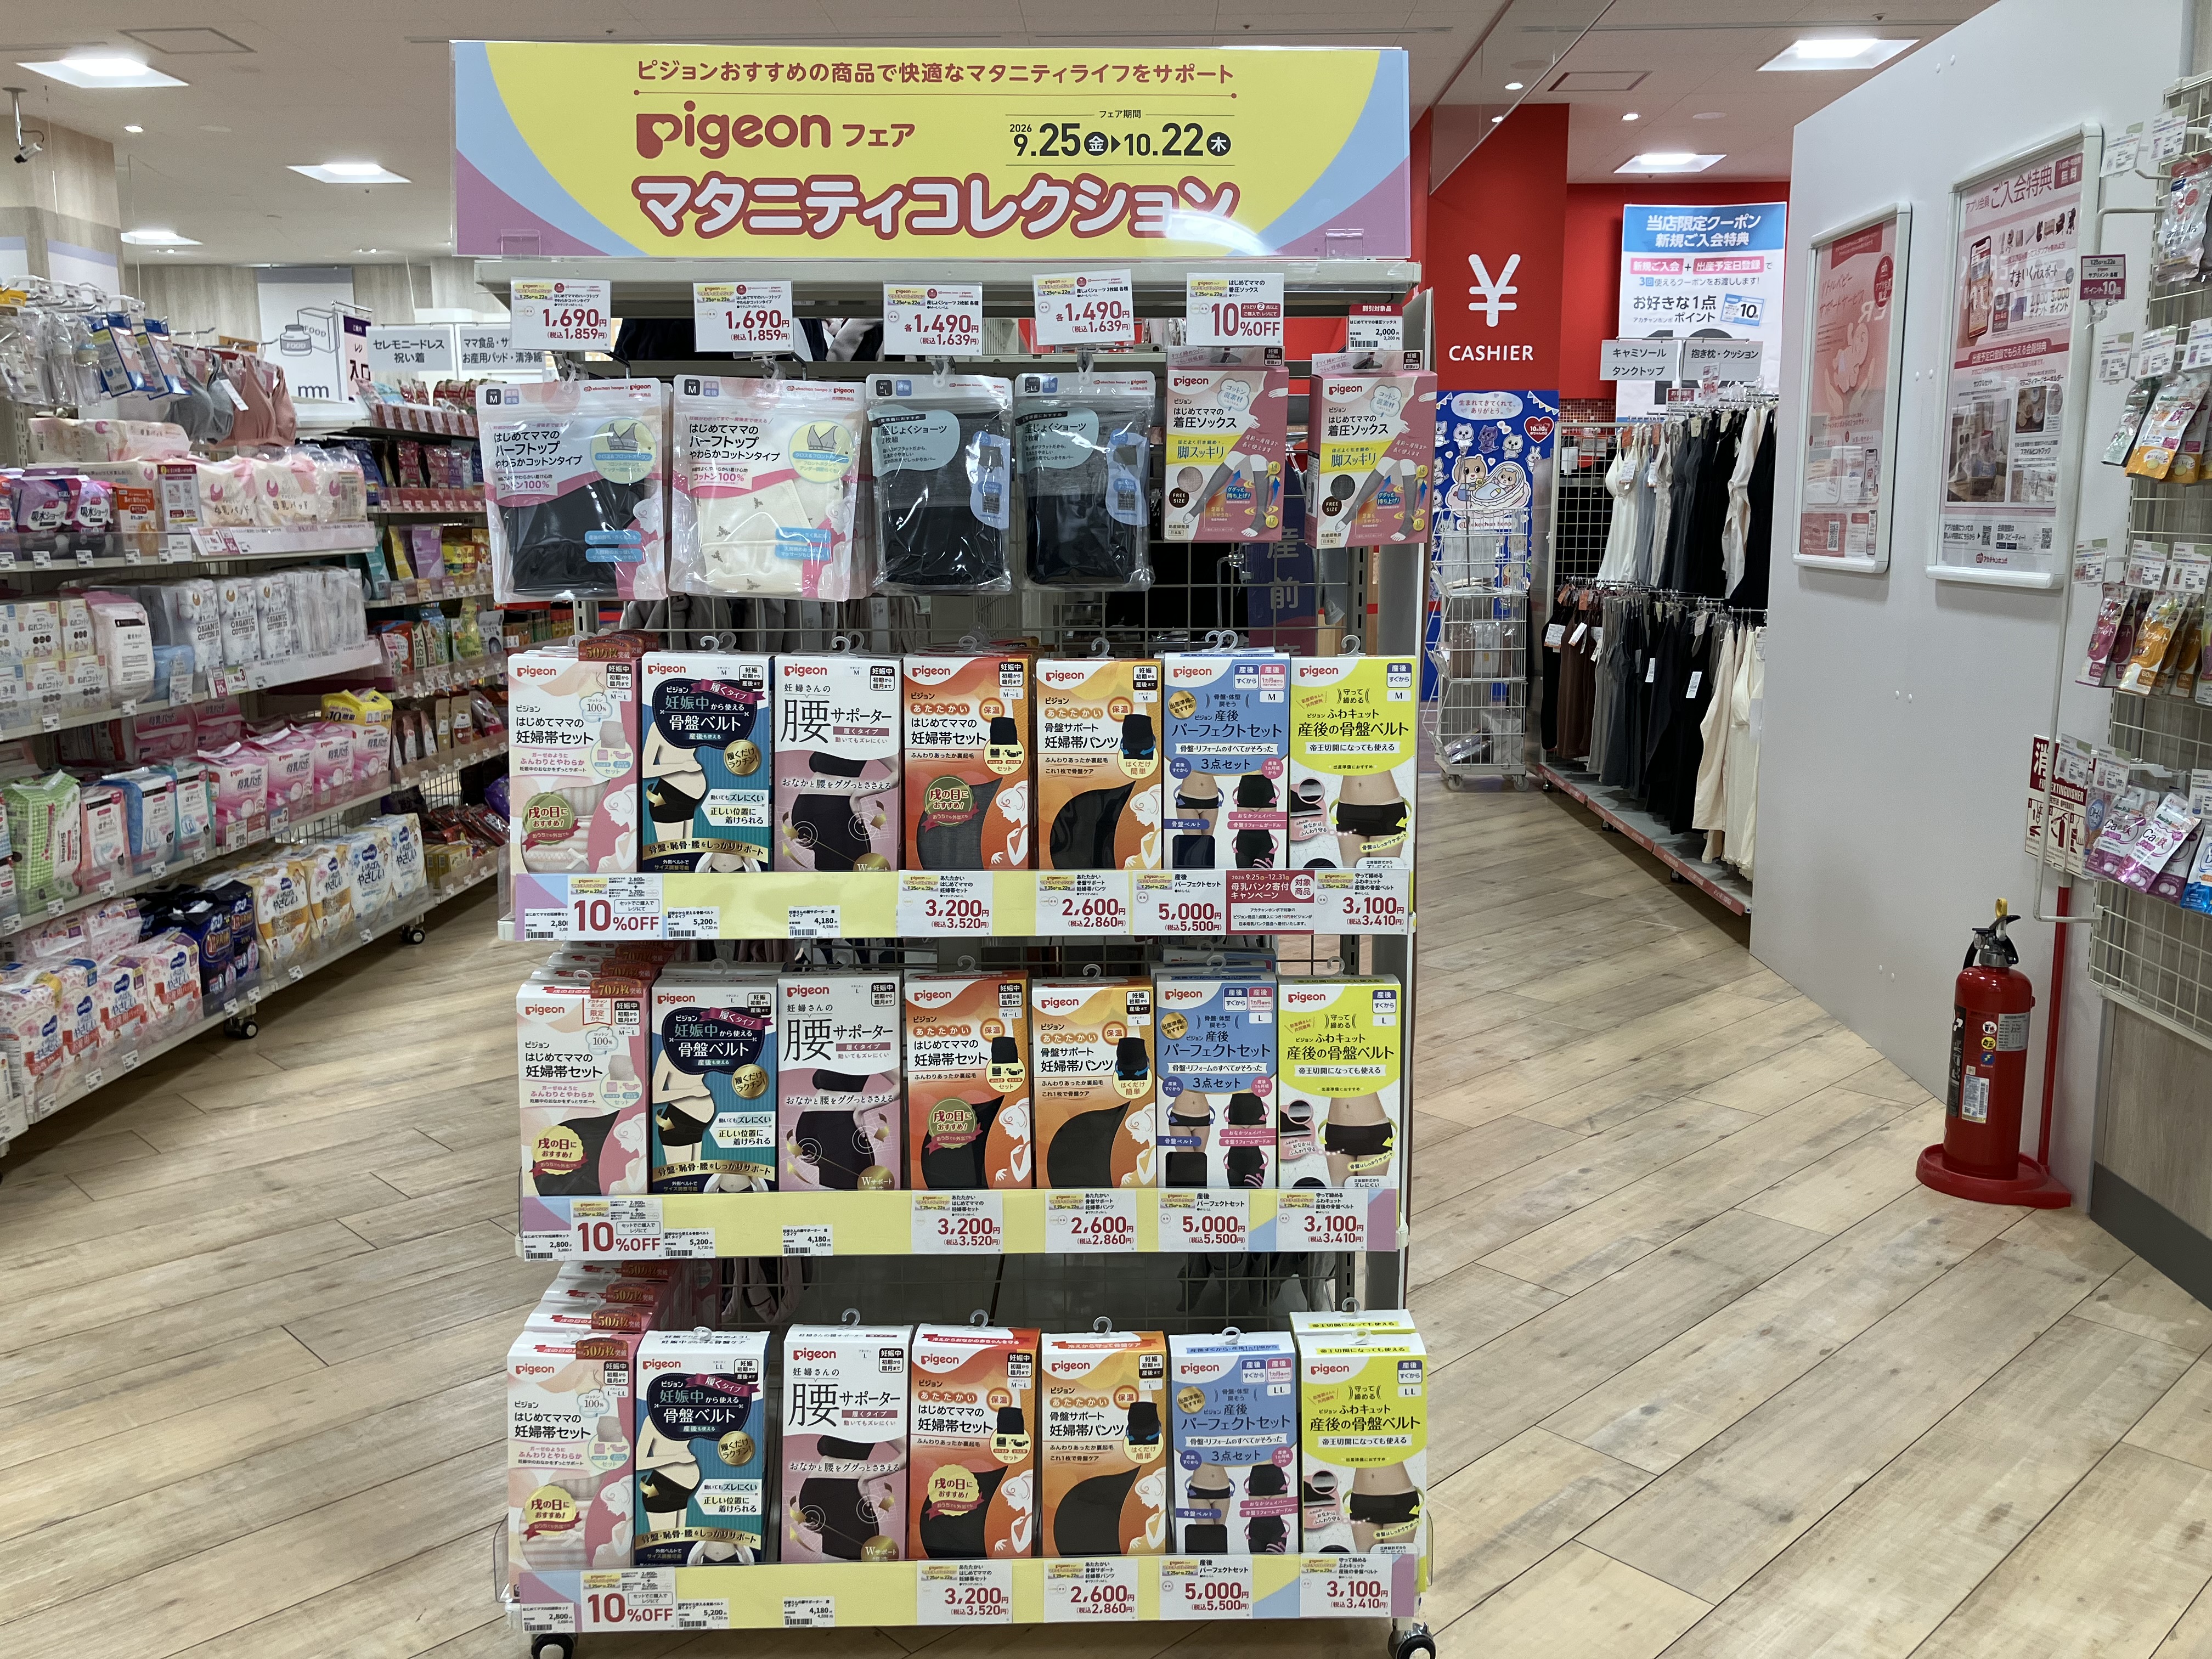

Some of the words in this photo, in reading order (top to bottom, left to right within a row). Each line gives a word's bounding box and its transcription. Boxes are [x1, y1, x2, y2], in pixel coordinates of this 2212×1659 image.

[636, 61, 1234, 85] ピジョンおすすめの商品で快適なマタニティライフをサポート
[1099, 109, 1141, 119] フェア期間
[636, 100, 831, 159] pigeon
[842, 122, 915, 147] フェア
[1010, 124, 1032, 133] 2026
[1992, 166, 2052, 208] ご入会特典
[633, 171, 1240, 240] マタニティコレクション
[1646, 214, 1761, 232] 当店限定クーポン
[1655, 233, 1750, 248] 新規ご入会特典
[1633, 260, 1679, 272] 新規ご入会
[1696, 259, 1760, 272] 出産予定日登録
[1633, 295, 1716, 310] お好きな1点
[543, 308, 607, 328] 1,690円
[726, 310, 789, 329] 1,690円
[1674, 312, 1716, 324] ポイント
[373, 338, 445, 350] セレモニードレス
[464, 338, 510, 348] ママ食品・サ
[394, 353, 424, 363] 祝い着
[1449, 345, 1533, 362] CASHIER
[1612, 348, 1666, 358] キャミソール
[1691, 348, 1758, 359] 抱き枕・クッション
[1612, 365, 1665, 376] タンクトップ
[1174, 375, 1209, 387] pigeon
[1329, 384, 1362, 395] pigeon
[1173, 417, 1237, 428] 着圧ソックス
[689, 424, 759, 435] はじめてママの
[1328, 424, 1389, 437] 着圧ソックス
[494, 431, 560, 443] はじめてママの
[689, 436, 759, 449] ハーフトップ
[496, 441, 561, 456] ハーフトップ
[1177, 446, 1224, 459] 脚スッキリ
[495, 455, 583, 469] やわらかコットンタイプ
[689, 450, 780, 461] やわらかコットンタイプ
[1331, 454, 1377, 467] 脚スッキリ
[230, 618, 255, 629] ORGANIC
[267, 614, 287, 624] ORGANIC
[517, 666, 556, 678] pigeon
[608, 664, 630, 673] 妊娠中
[647, 663, 686, 675] pigeon
[784, 664, 827, 677] pigeon
[912, 666, 951, 679] pigeon
[1392, 665, 1410, 673] 産後
[784, 684, 831, 693] 妊婦さんの
[665, 696, 709, 710] 妊娠中
[710, 703, 745, 712] から使える
[913, 704, 968, 714] あたたかい
[984, 706, 1001, 715] 保温
[1327, 709, 1379, 719] ふわキュット
[516, 718, 584, 729] はじめてママの
[669, 715, 741, 732] 骨盤ベルト
[781, 699, 830, 744] 腰
[831, 710, 892, 724] サポーター
[1045, 723, 1098, 733] 骨盤サポート
[1171, 723, 1282, 738] パーフェクトセット
[1298, 721, 1409, 737] 産後の骨盤ベルト
[515, 731, 594, 745] 妊婦帯セット
[911, 731, 986, 746] 妊婦帯セット
[1044, 735, 1119, 748] 妊婦帯パンツ
[1310, 743, 1394, 752] 帝王切開になっても使える
[1201, 758, 1250, 771] 3点セット
[782, 778, 891, 790] おなかと腰をググっとささえる
[711, 793, 764, 803] 動いてもズレにくい
[529, 807, 568, 819] 戌の日に
[710, 808, 755, 816] 正しい位置に
[725, 816, 764, 825] 着けられる
[1231, 882, 1289, 891] 母乳バンク寄付
[1230, 891, 1279, 899] キャンペーン
[925, 898, 989, 918] 3,200円
[1062, 898, 1126, 916] 2,600円
[1158, 902, 1221, 921] 5,000円
[1342, 896, 1404, 915] 3,100円
[678, 1043, 749, 1058] 骨盤ベルト
[1164, 1043, 1271, 1058] パーフェクトセット
[1286, 1045, 1394, 1060] 産後の骨盤ベルト
[914, 1052, 988, 1066] 妊婦帯セット
[1041, 1058, 1113, 1073] 妊婦帯パンツ
[526, 1065, 603, 1079] 妊婦帯セット
[938, 1217, 1000, 1235] 3,200円
[1070, 1216, 1133, 1234] 2,600円
[1182, 1216, 1245, 1234] 5,000円
[1304, 1215, 1363, 1233] 3,100円
[664, 1409, 736, 1424] 骨盤ベルト
[1181, 1415, 1291, 1430] パーフェクトセット
[1311, 1415, 1420, 1431] 産後の骨盤ベルト
[515, 1425, 591, 1439] 妊婦帯セット
[918, 1419, 992, 1434] 妊婦帯セット
[1049, 1424, 1125, 1437] 妊婦帯パンツ
[1070, 1585, 1135, 1603] 2,600円
[1184, 1582, 1249, 1600] 5,000円
[1326, 1580, 1388, 1598] 3,100円
[944, 1587, 1009, 1605] 3,200円
